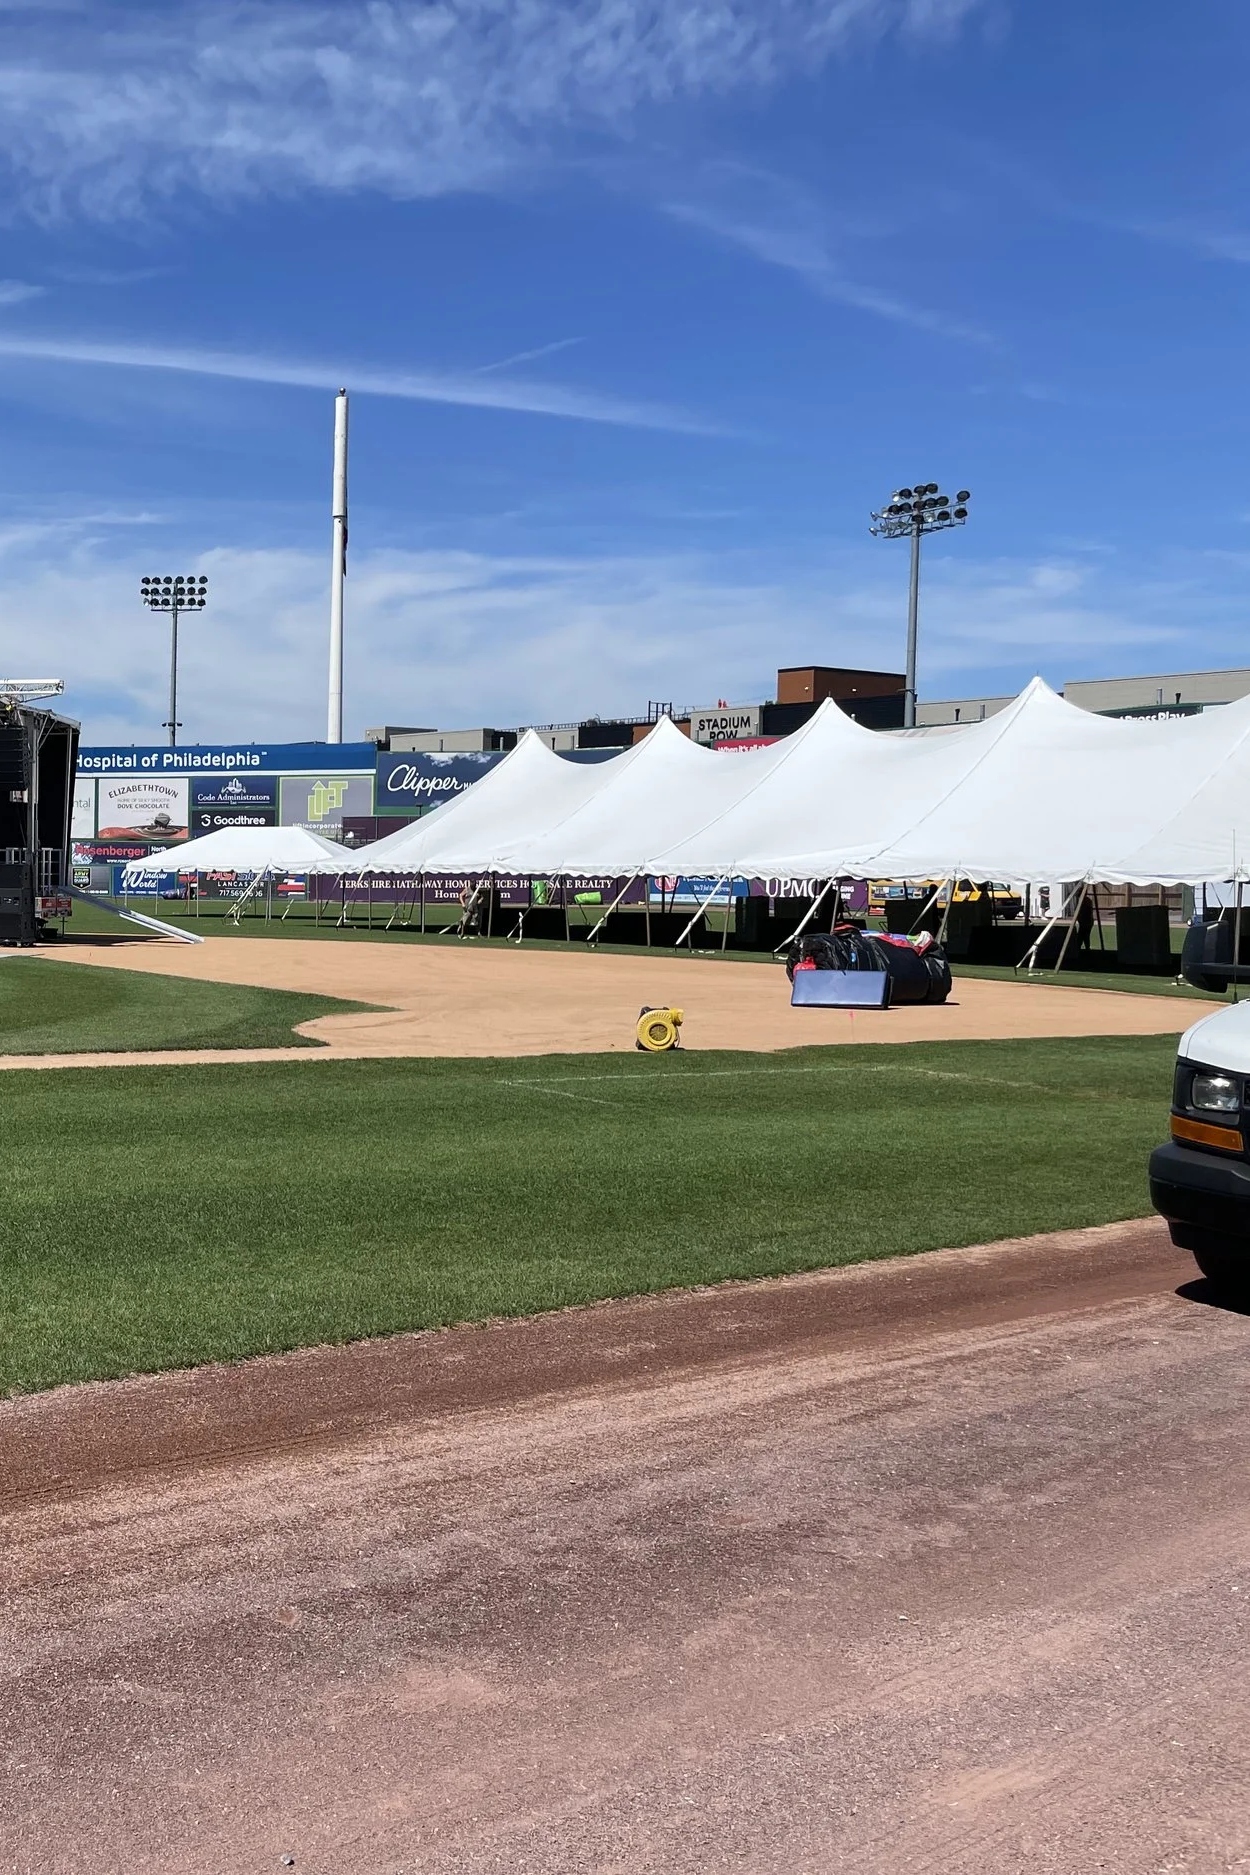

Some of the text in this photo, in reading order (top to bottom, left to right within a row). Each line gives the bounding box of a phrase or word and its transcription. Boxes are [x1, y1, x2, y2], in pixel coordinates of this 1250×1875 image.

[698, 715, 751, 731] STADIUM
[76, 751, 261, 771] Hospital of Philadelphia
[387, 764, 463, 797] Clipper
[108, 784, 179, 799] ELIZABETHTOWN
[197, 793, 270, 801] Code Administrators
[73, 797, 91, 808] ntal
[213, 815, 266, 825] Goodthree
[75, 844, 146, 858] Rosenberger
[574, 879, 614, 889] REALTY
